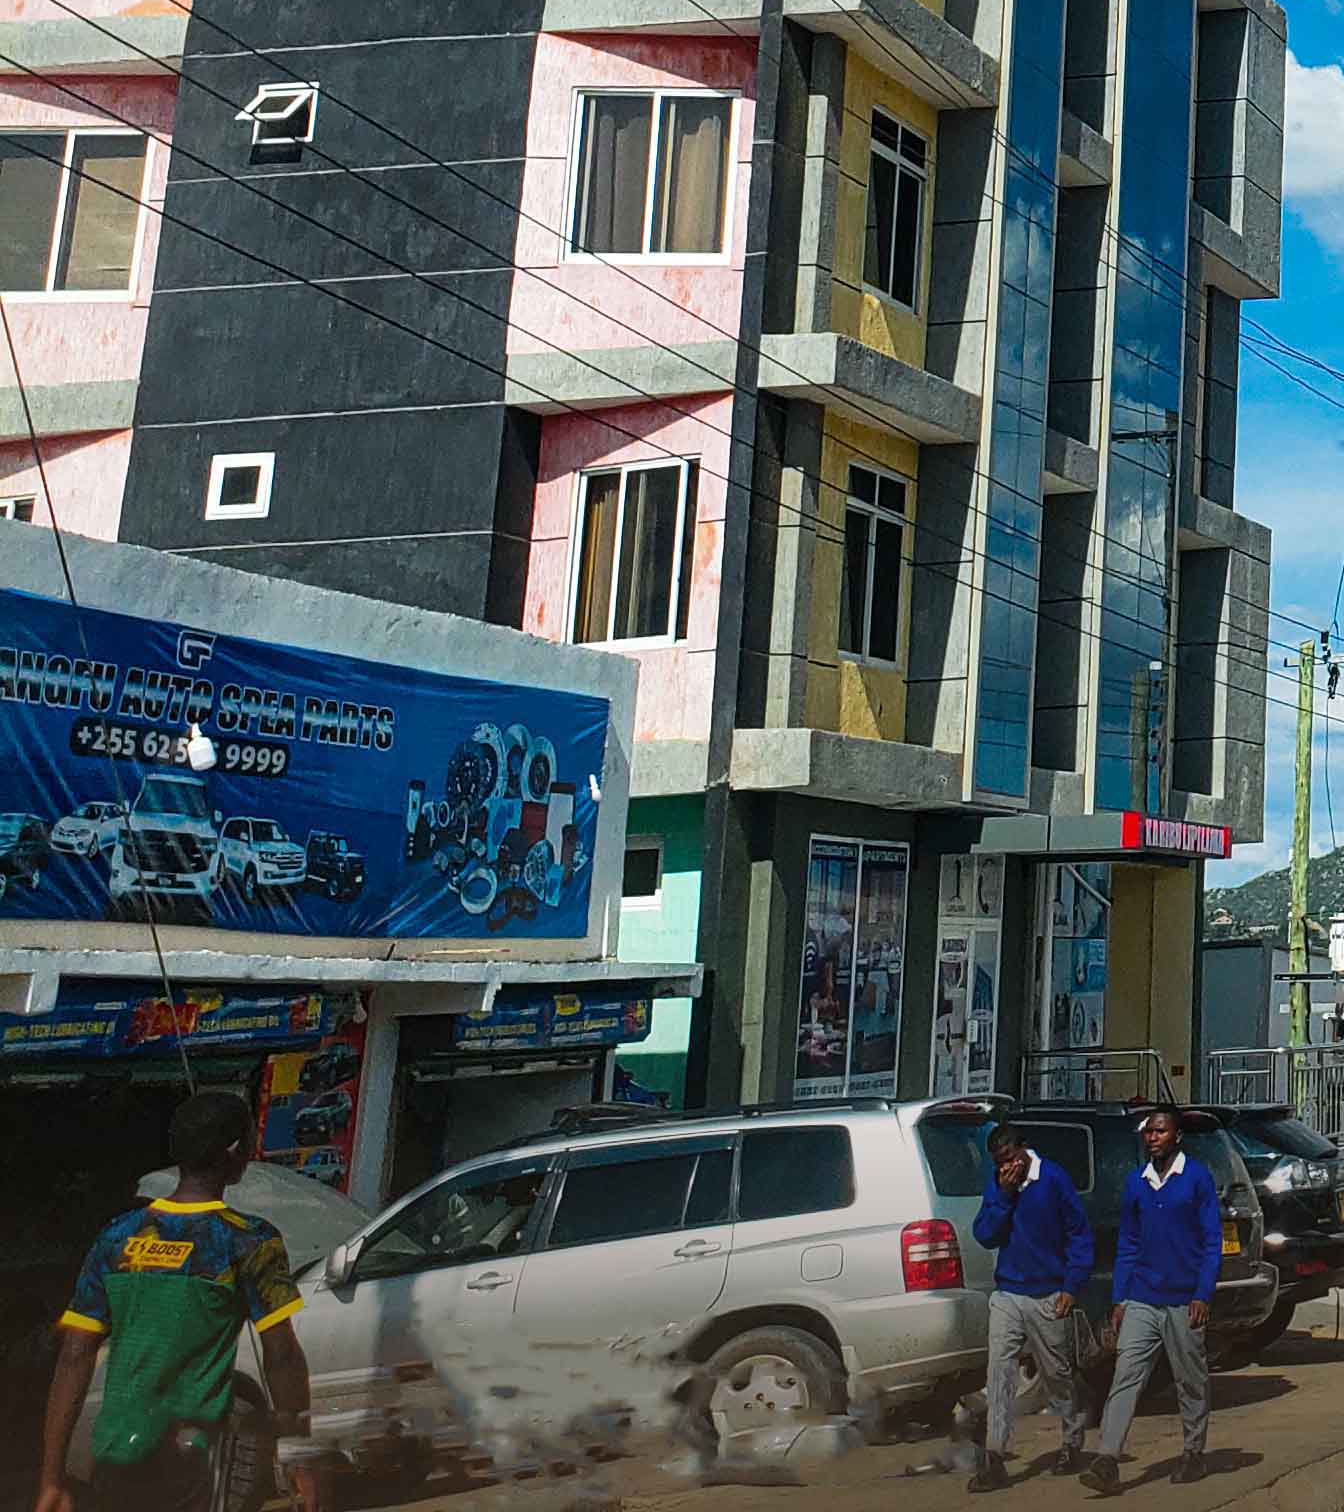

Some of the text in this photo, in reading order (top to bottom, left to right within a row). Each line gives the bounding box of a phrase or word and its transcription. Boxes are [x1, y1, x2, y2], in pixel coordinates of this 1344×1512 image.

[116, 666, 214, 727] AUTO
[216, 682, 297, 740] SPEA
[300, 695, 396, 752] PARTS
[77, 725, 137, 757] +255
[225, 743, 286, 775] 9999
